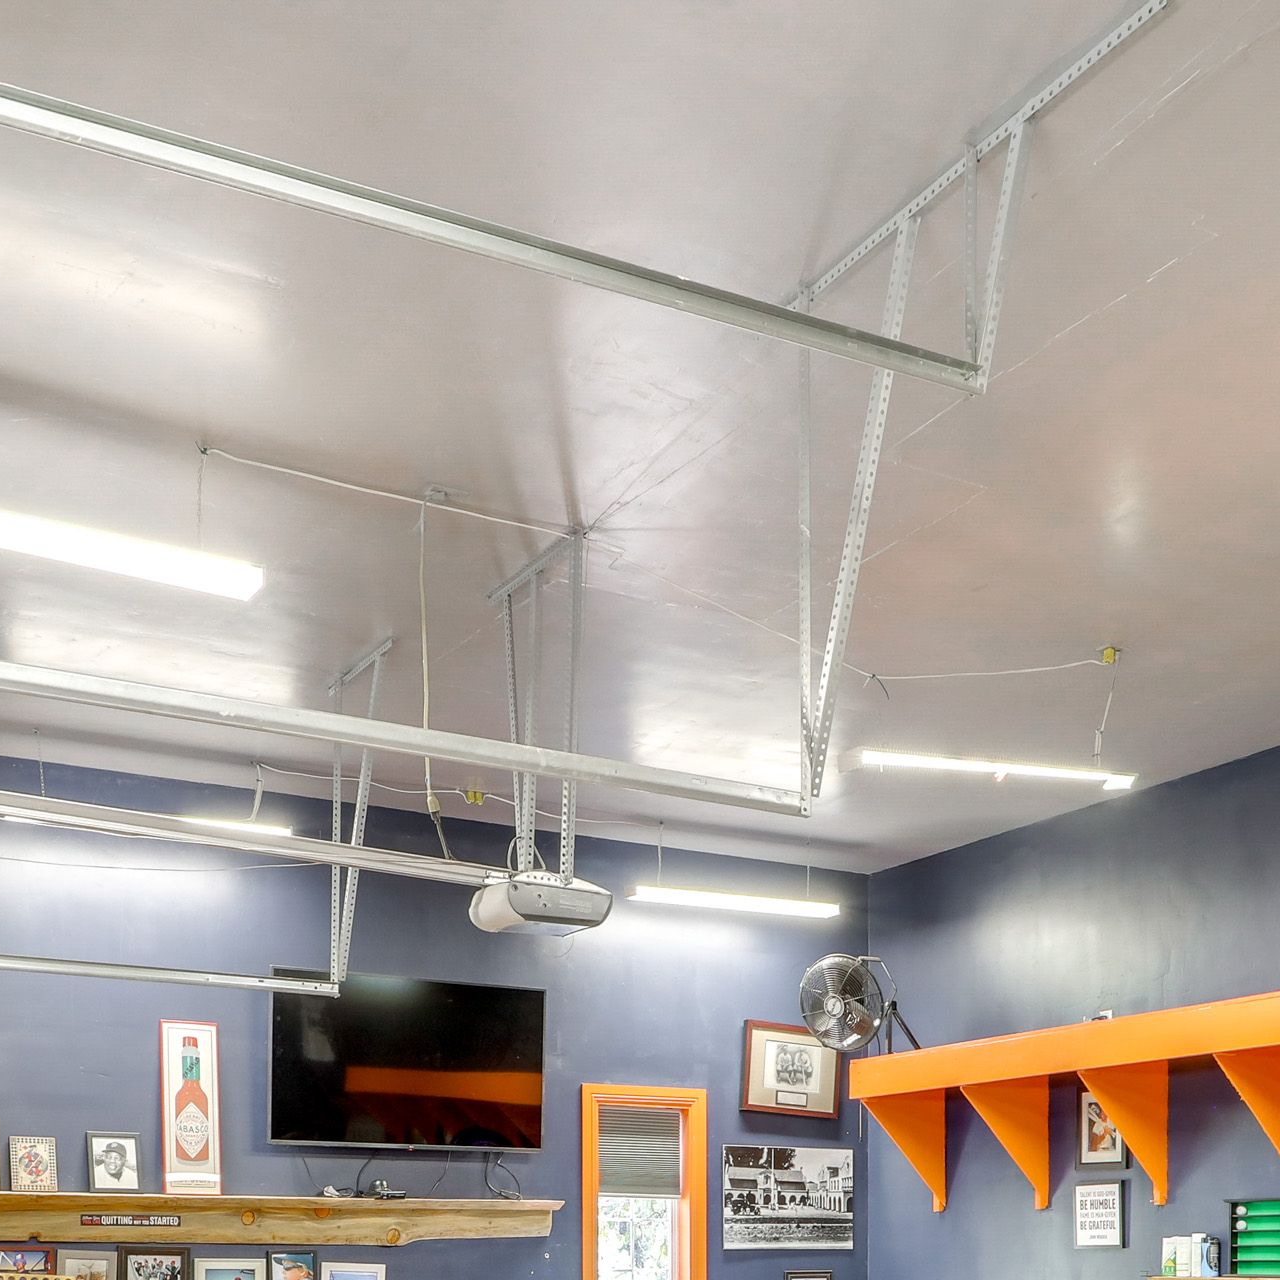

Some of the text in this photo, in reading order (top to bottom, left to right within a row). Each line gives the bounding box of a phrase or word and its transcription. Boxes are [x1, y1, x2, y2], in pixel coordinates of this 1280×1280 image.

[176, 1124, 209, 1133] TABASCO
[1080, 1199, 1116, 1210] BE HUMBLE
[101, 1215, 132, 1225] QUITTING
[150, 1216, 179, 1225] STARTED
[1080, 1220, 1116, 1230] BE GRATEFUL
